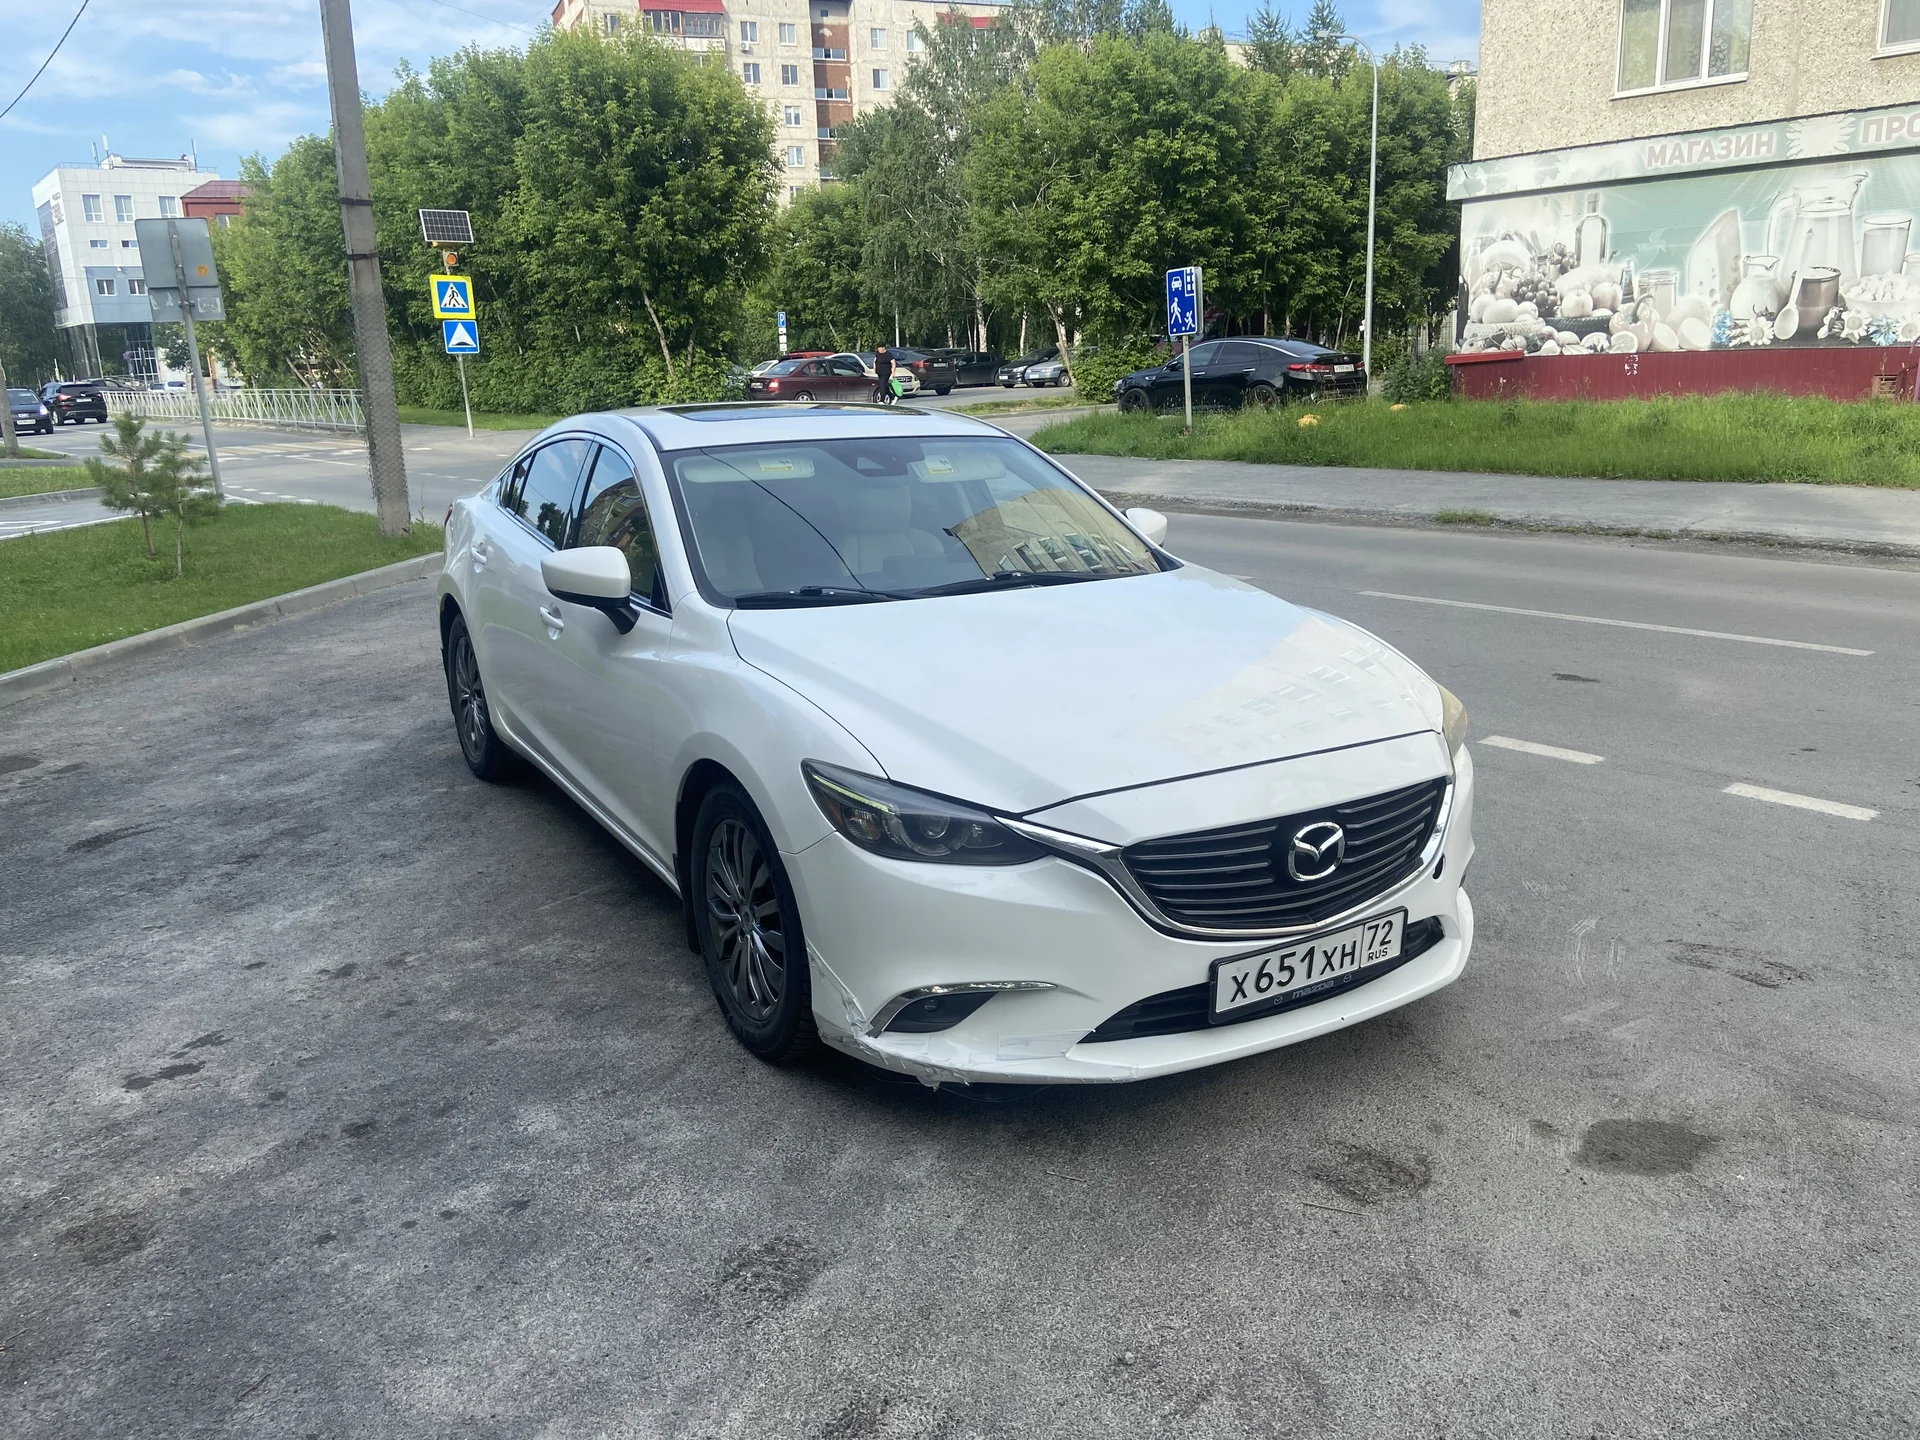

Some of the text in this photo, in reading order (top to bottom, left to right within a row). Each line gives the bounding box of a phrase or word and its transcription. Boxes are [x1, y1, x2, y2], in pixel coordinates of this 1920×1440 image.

[1647, 131, 1775, 168] МАГАЗИН
[1230, 919, 1394, 1003] Х651ХН 72
[1367, 947, 1388, 962] RUS
